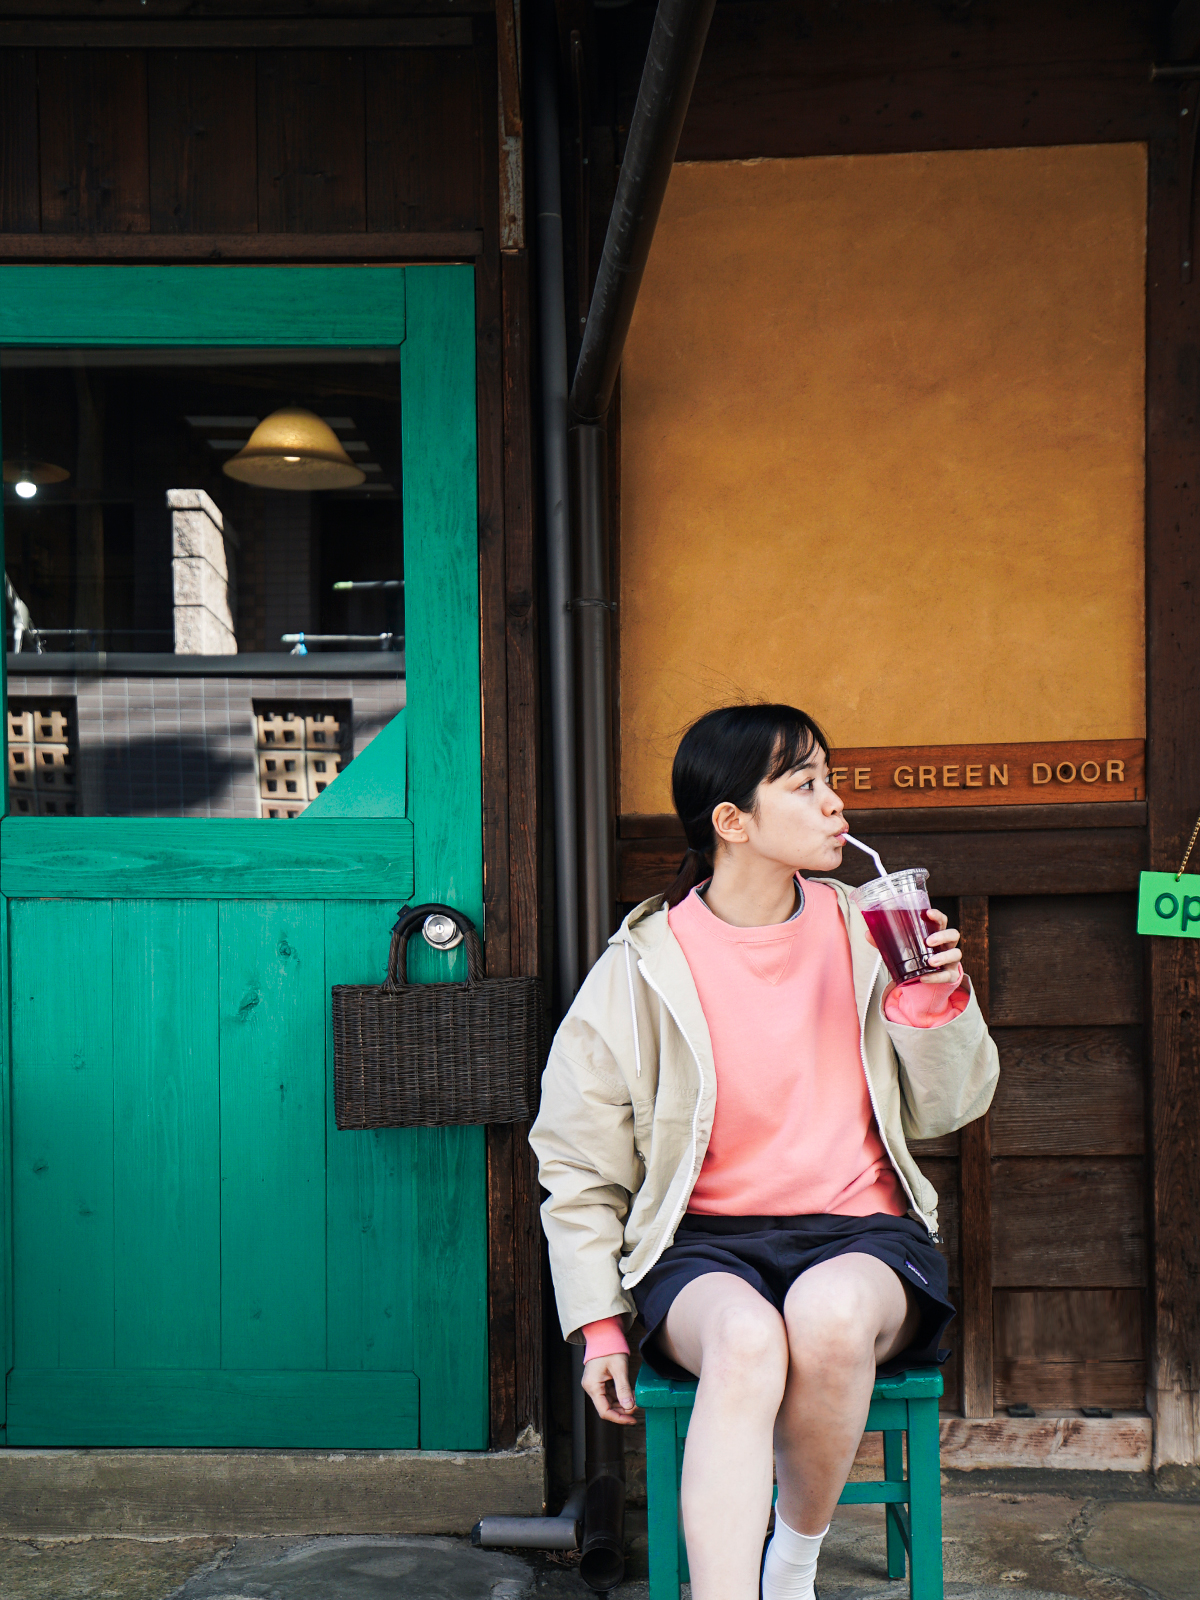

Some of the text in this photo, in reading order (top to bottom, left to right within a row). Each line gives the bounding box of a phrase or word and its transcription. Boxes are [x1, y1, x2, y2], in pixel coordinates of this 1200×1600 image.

[831, 759, 1126, 790] FE GREEN DOOR
[1154, 892, 1200, 932] op
